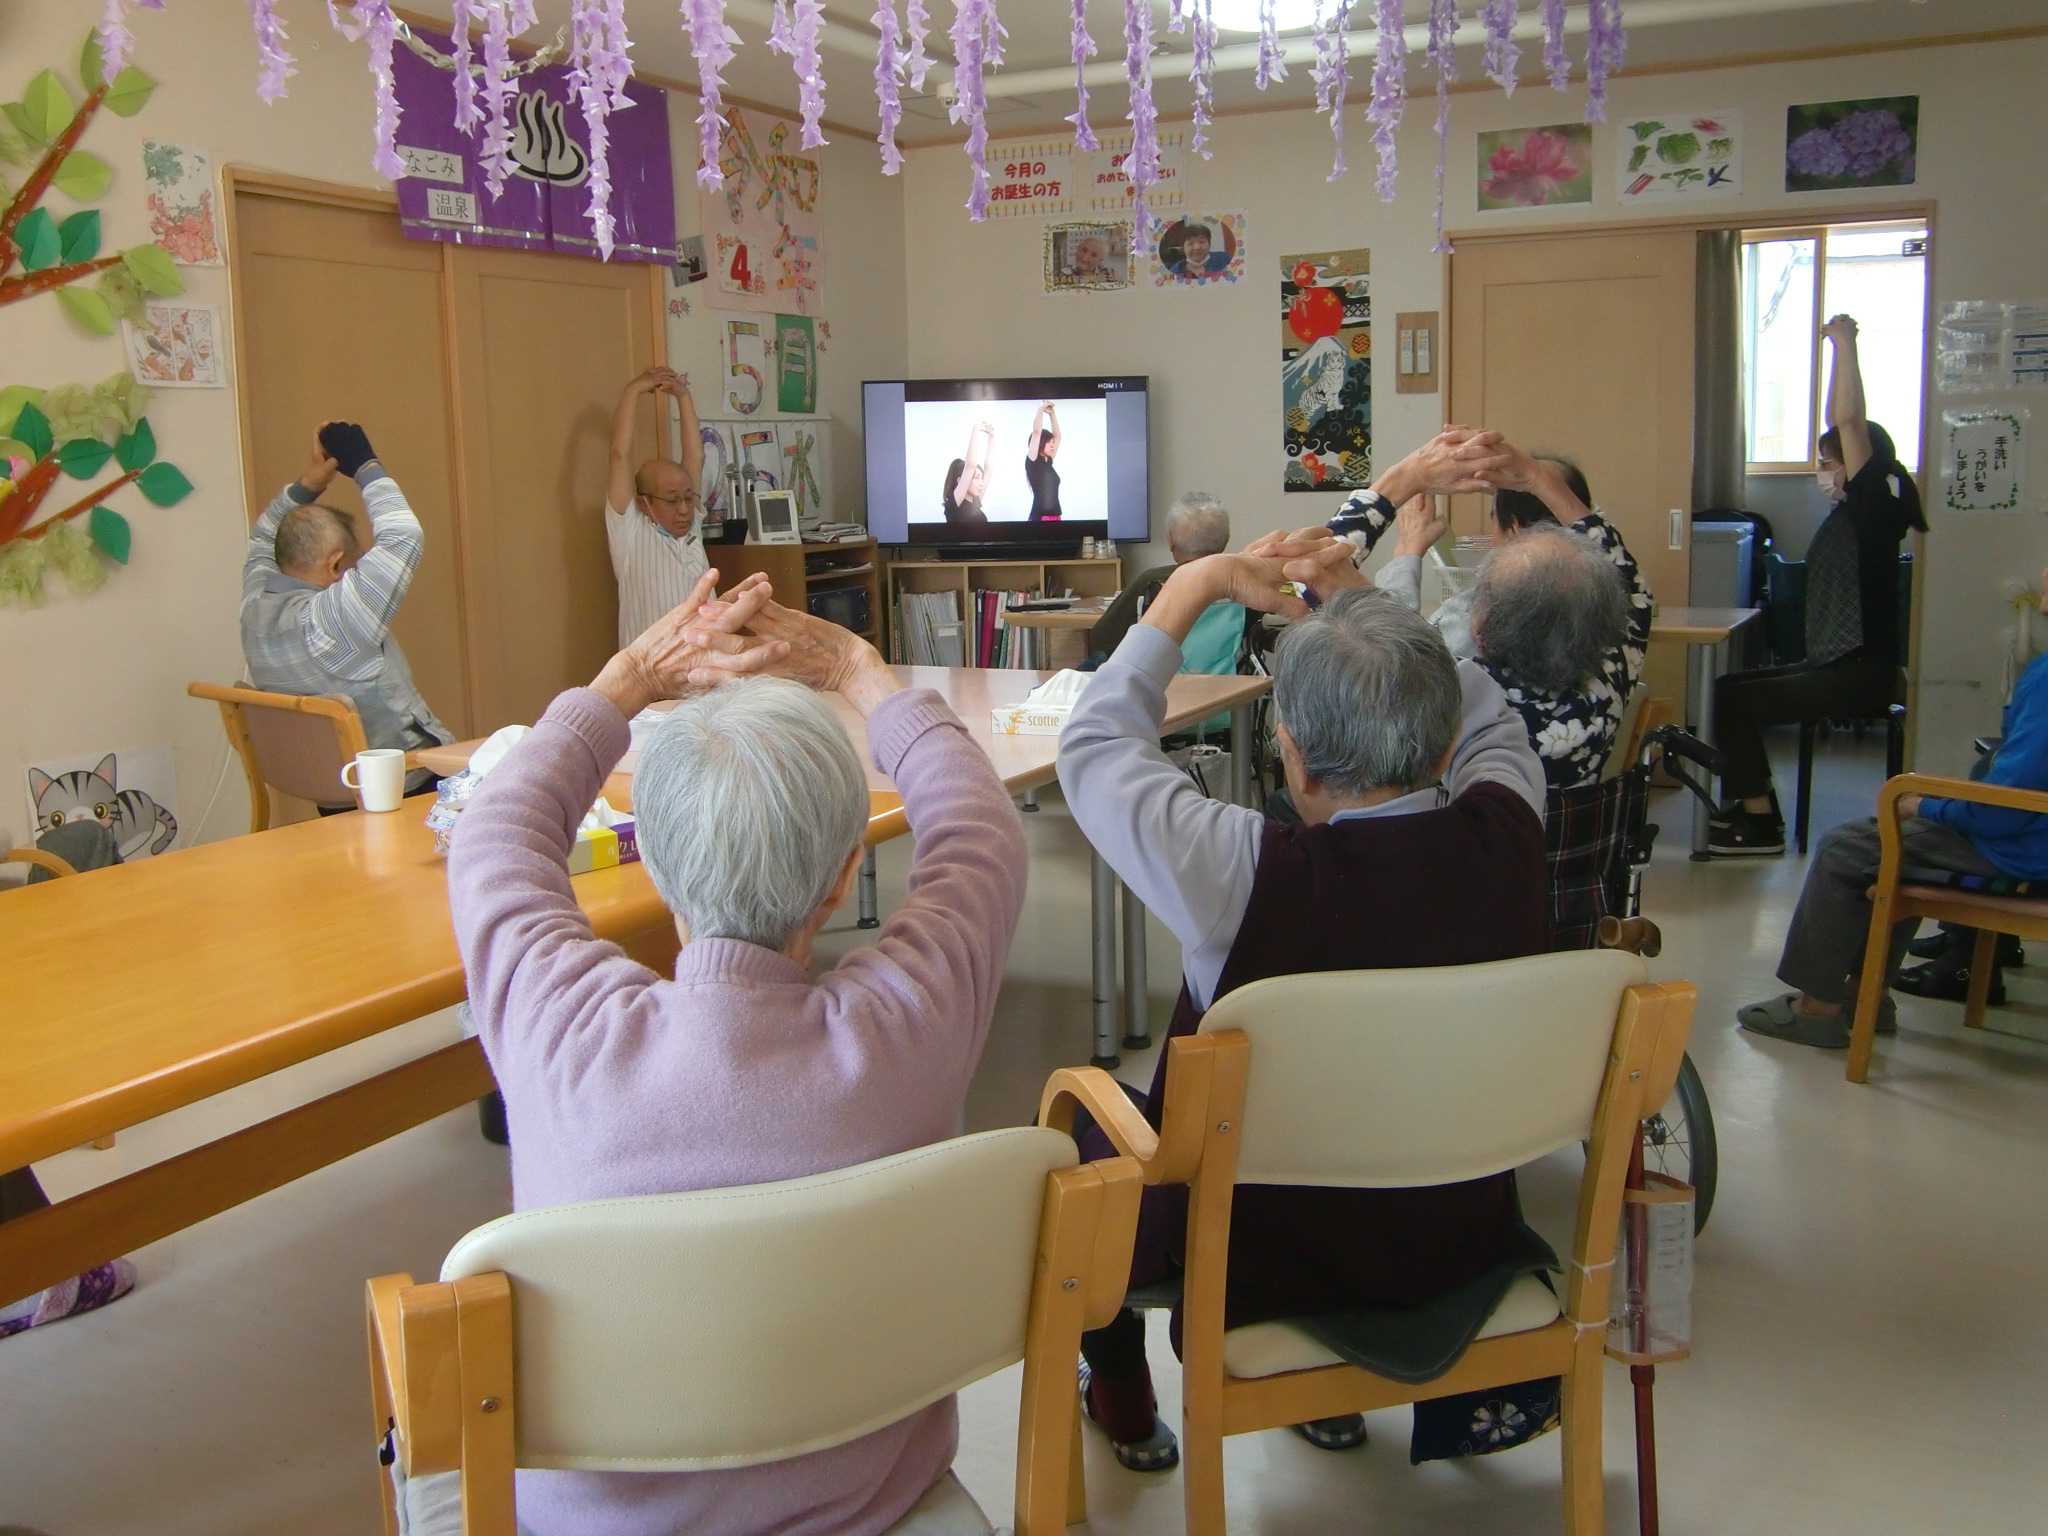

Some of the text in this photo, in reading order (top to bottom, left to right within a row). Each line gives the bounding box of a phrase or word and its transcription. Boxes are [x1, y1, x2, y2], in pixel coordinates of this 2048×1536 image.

[406, 150, 456, 177] なごみ
[698, 107, 819, 227] 令和
[1003, 161, 1047, 179] 今月の
[435, 193, 469, 219] 温泉
[991, 180, 1062, 201] お誕生の方
[727, 320, 814, 415] 5月
[1994, 436, 2007, 471] 手洗い
[1955, 449, 1967, 499] しましょう
[1974, 449, 1987, 492] うがいを
[1027, 715, 1060, 727] scottie
